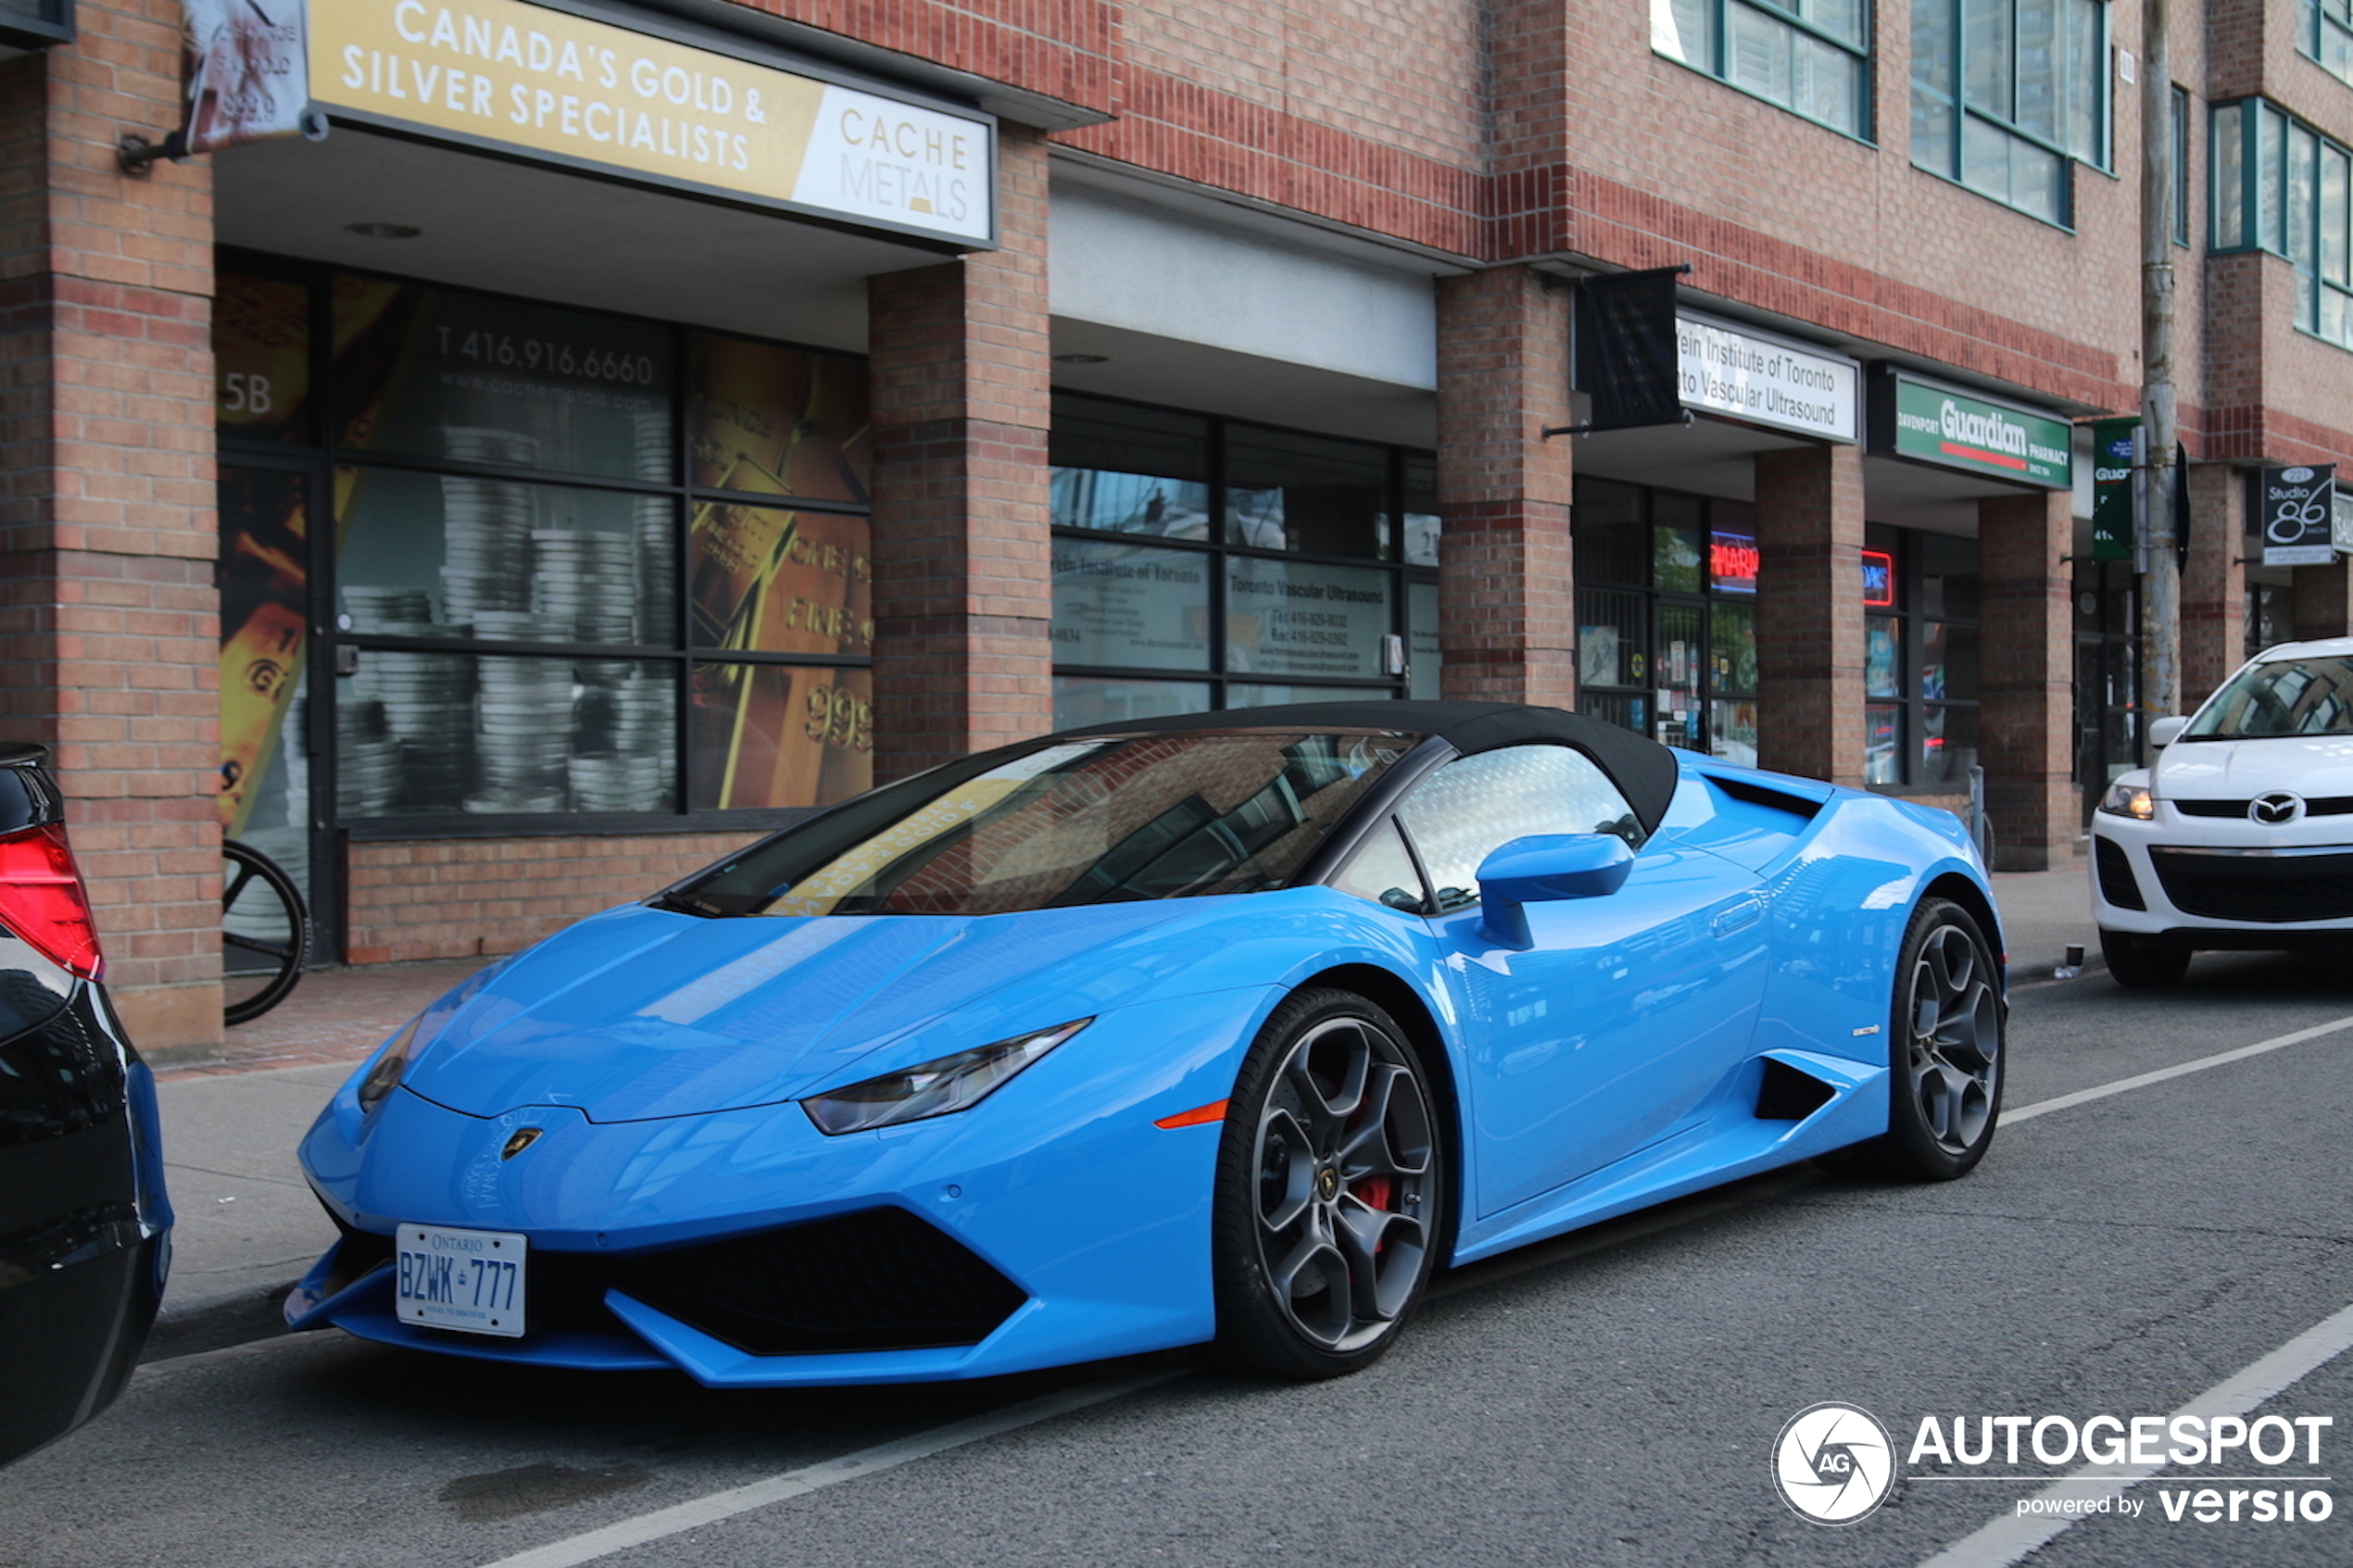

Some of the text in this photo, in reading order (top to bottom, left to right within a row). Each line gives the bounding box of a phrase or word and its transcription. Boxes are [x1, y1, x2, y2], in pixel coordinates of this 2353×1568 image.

[394, 0, 766, 124] CANADA'S GOLD &
[342, 44, 749, 171] SILVER SPECIALISTS
[840, 108, 966, 169] CACHE
[841, 153, 966, 221] METALS
[439, 326, 652, 384] T 416.916.6660
[1706, 337, 1764, 373] Institute
[1768, 358, 1783, 379] of
[1785, 358, 1835, 392] Toronto
[439, 371, 651, 411] www.cachemetals.com
[1702, 371, 1763, 409] Vascular
[1766, 387, 1835, 426] Ultrasound
[1897, 411, 1940, 435] DAVENPORT
[1941, 399, 2027, 456] Guardian
[2029, 442, 2069, 467] PHARMACY
[2267, 477, 2333, 545] 86
[2269, 485, 2309, 500] Studio
[790, 537, 849, 577] ONE
[1137, 563, 1151, 579] of
[1153, 564, 1202, 584] Toronto
[1231, 575, 1384, 604] Toronto Vascular Ultrasound
[786, 596, 853, 644] FINE
[432, 1235, 483, 1253] ONTARIO
[400, 1251, 517, 1311] BZWK 777
